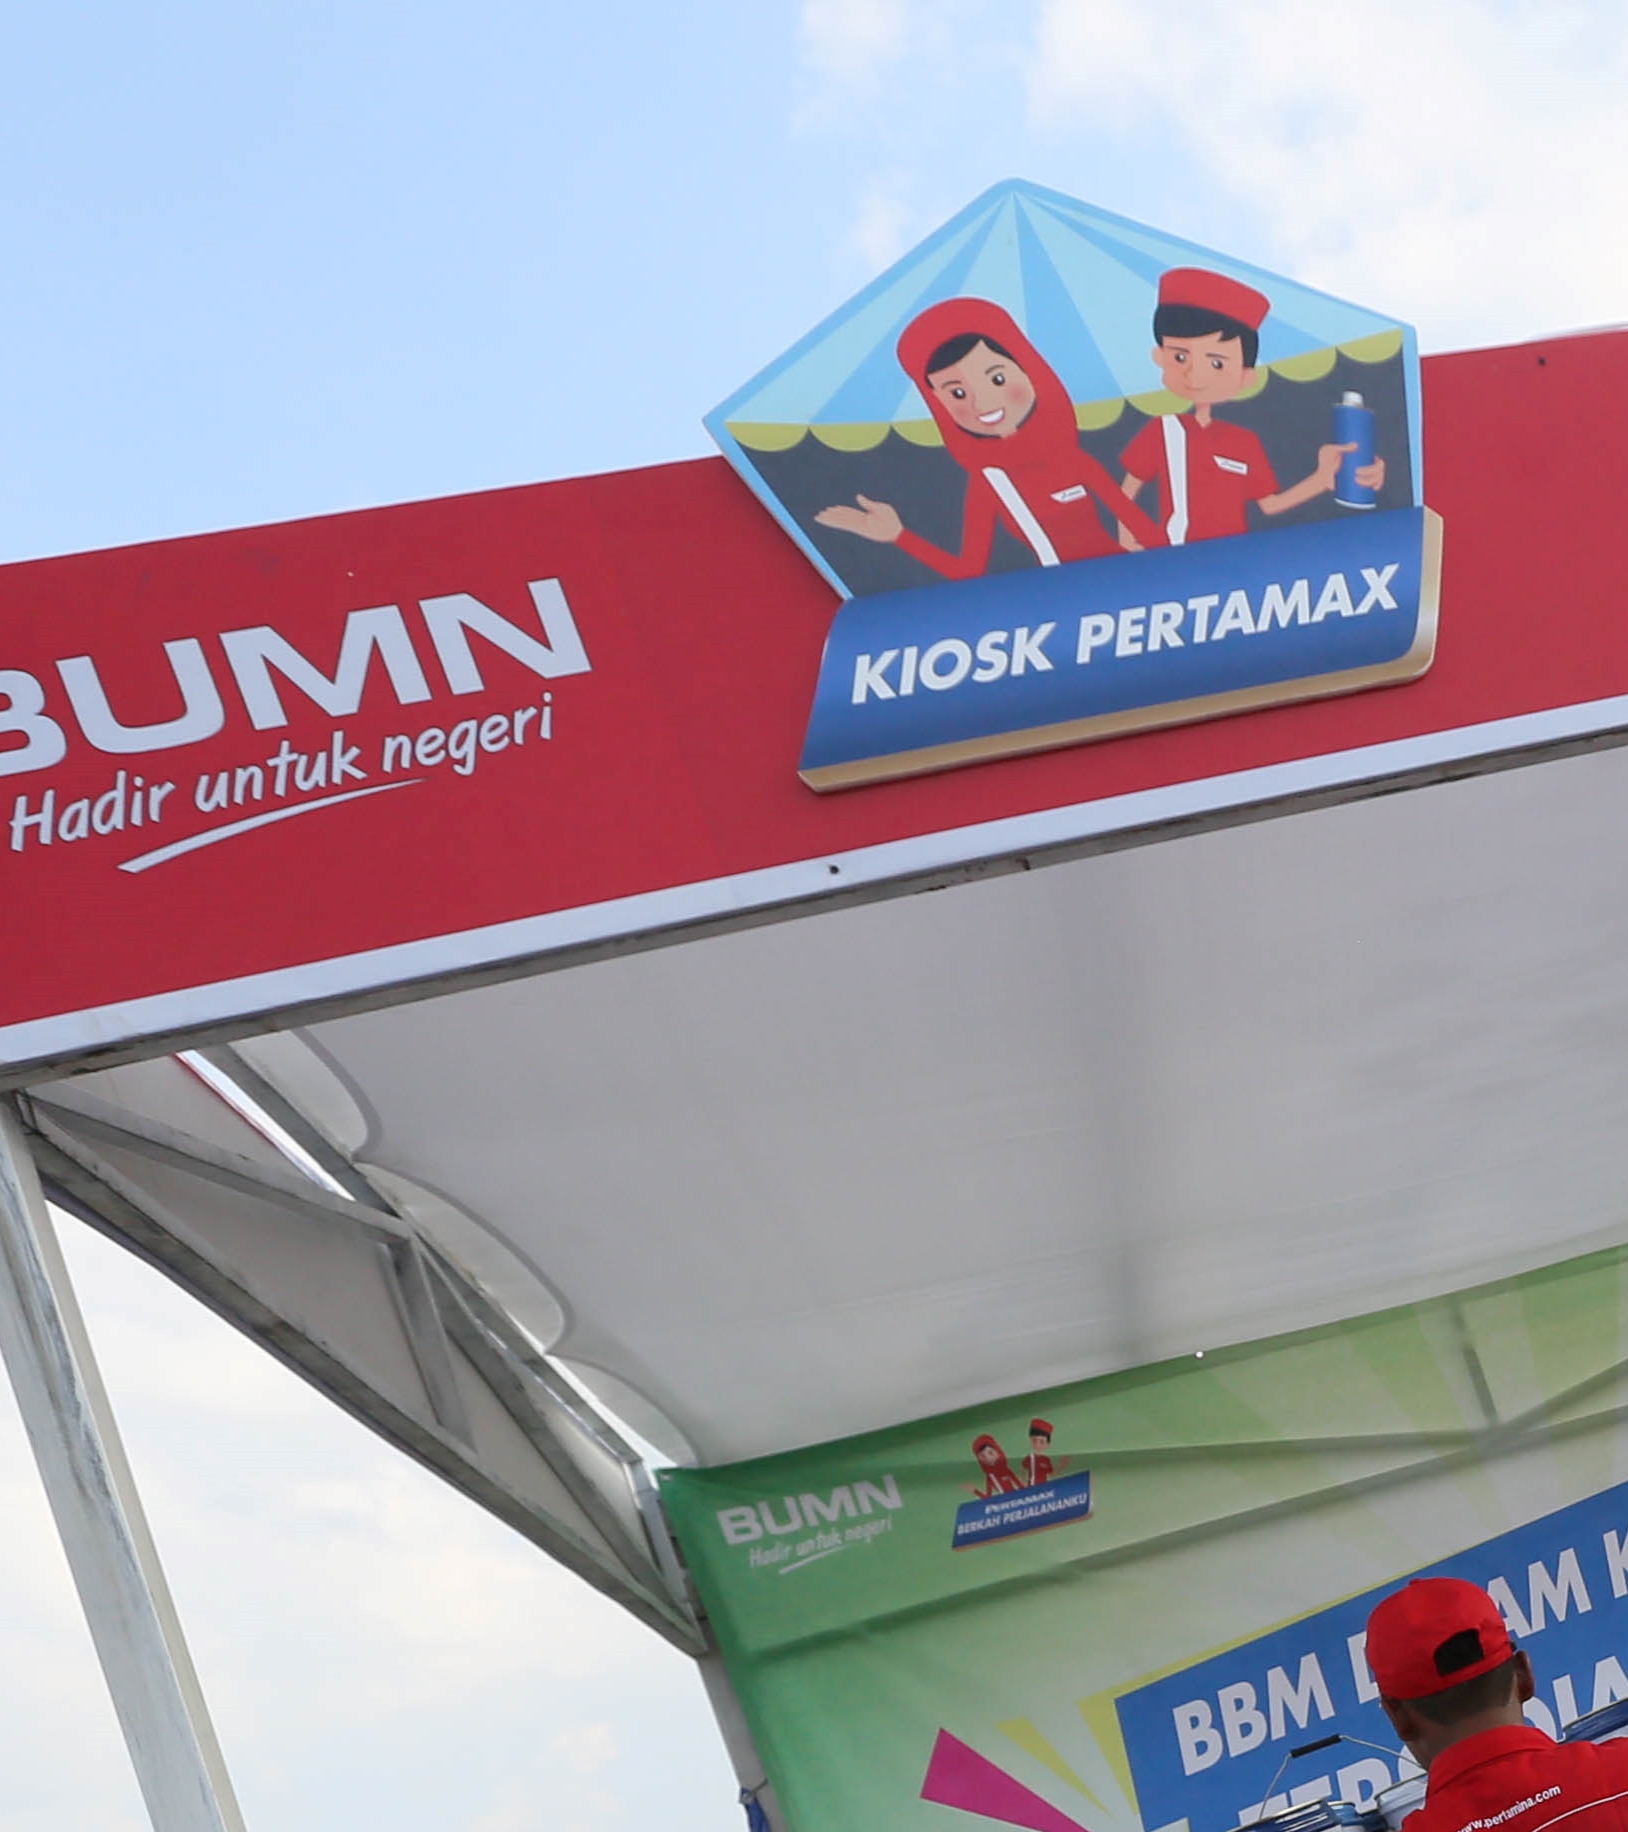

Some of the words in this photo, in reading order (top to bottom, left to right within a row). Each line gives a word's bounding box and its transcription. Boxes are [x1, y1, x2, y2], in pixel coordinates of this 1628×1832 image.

[0, 577, 592, 776] BUMN
[851, 621, 1058, 705] KIOSK
[1076, 563, 1398, 663] PERTAMAX
[9, 770, 176, 852] Hadir
[194, 731, 370, 812] untuk
[382, 691, 554, 775] negeri
[716, 1474, 903, 1545] BUMN
[749, 1543, 791, 1569] Hadir
[796, 1530, 842, 1557] untuk
[846, 1516, 893, 1545] negeri
[957, 1516, 1001, 1536] BERKAH
[1002, 1492, 1088, 1525] PERJALANANKU
[1172, 1652, 1335, 1777] BBM
